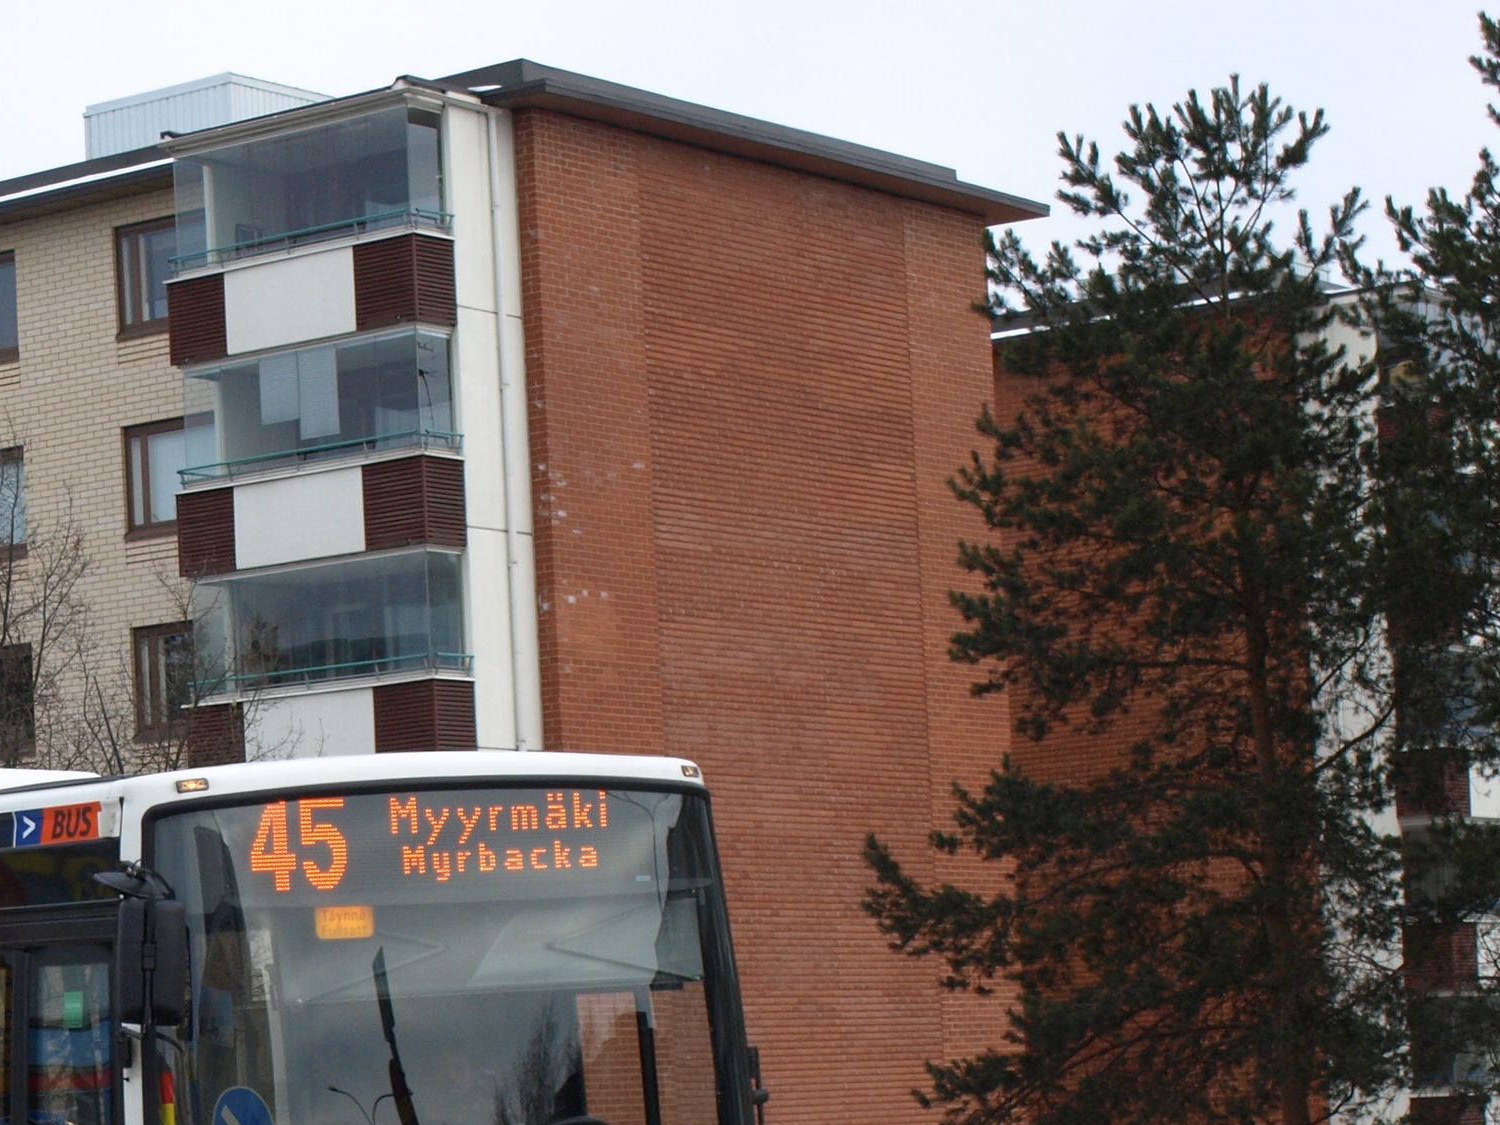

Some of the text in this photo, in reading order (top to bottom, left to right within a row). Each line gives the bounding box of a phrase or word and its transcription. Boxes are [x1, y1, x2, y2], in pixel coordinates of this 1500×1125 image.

[51, 806, 92, 838] BUS
[251, 791, 608, 891] 45 Myyrmäki
[403, 840, 598, 882] Myrbacka
